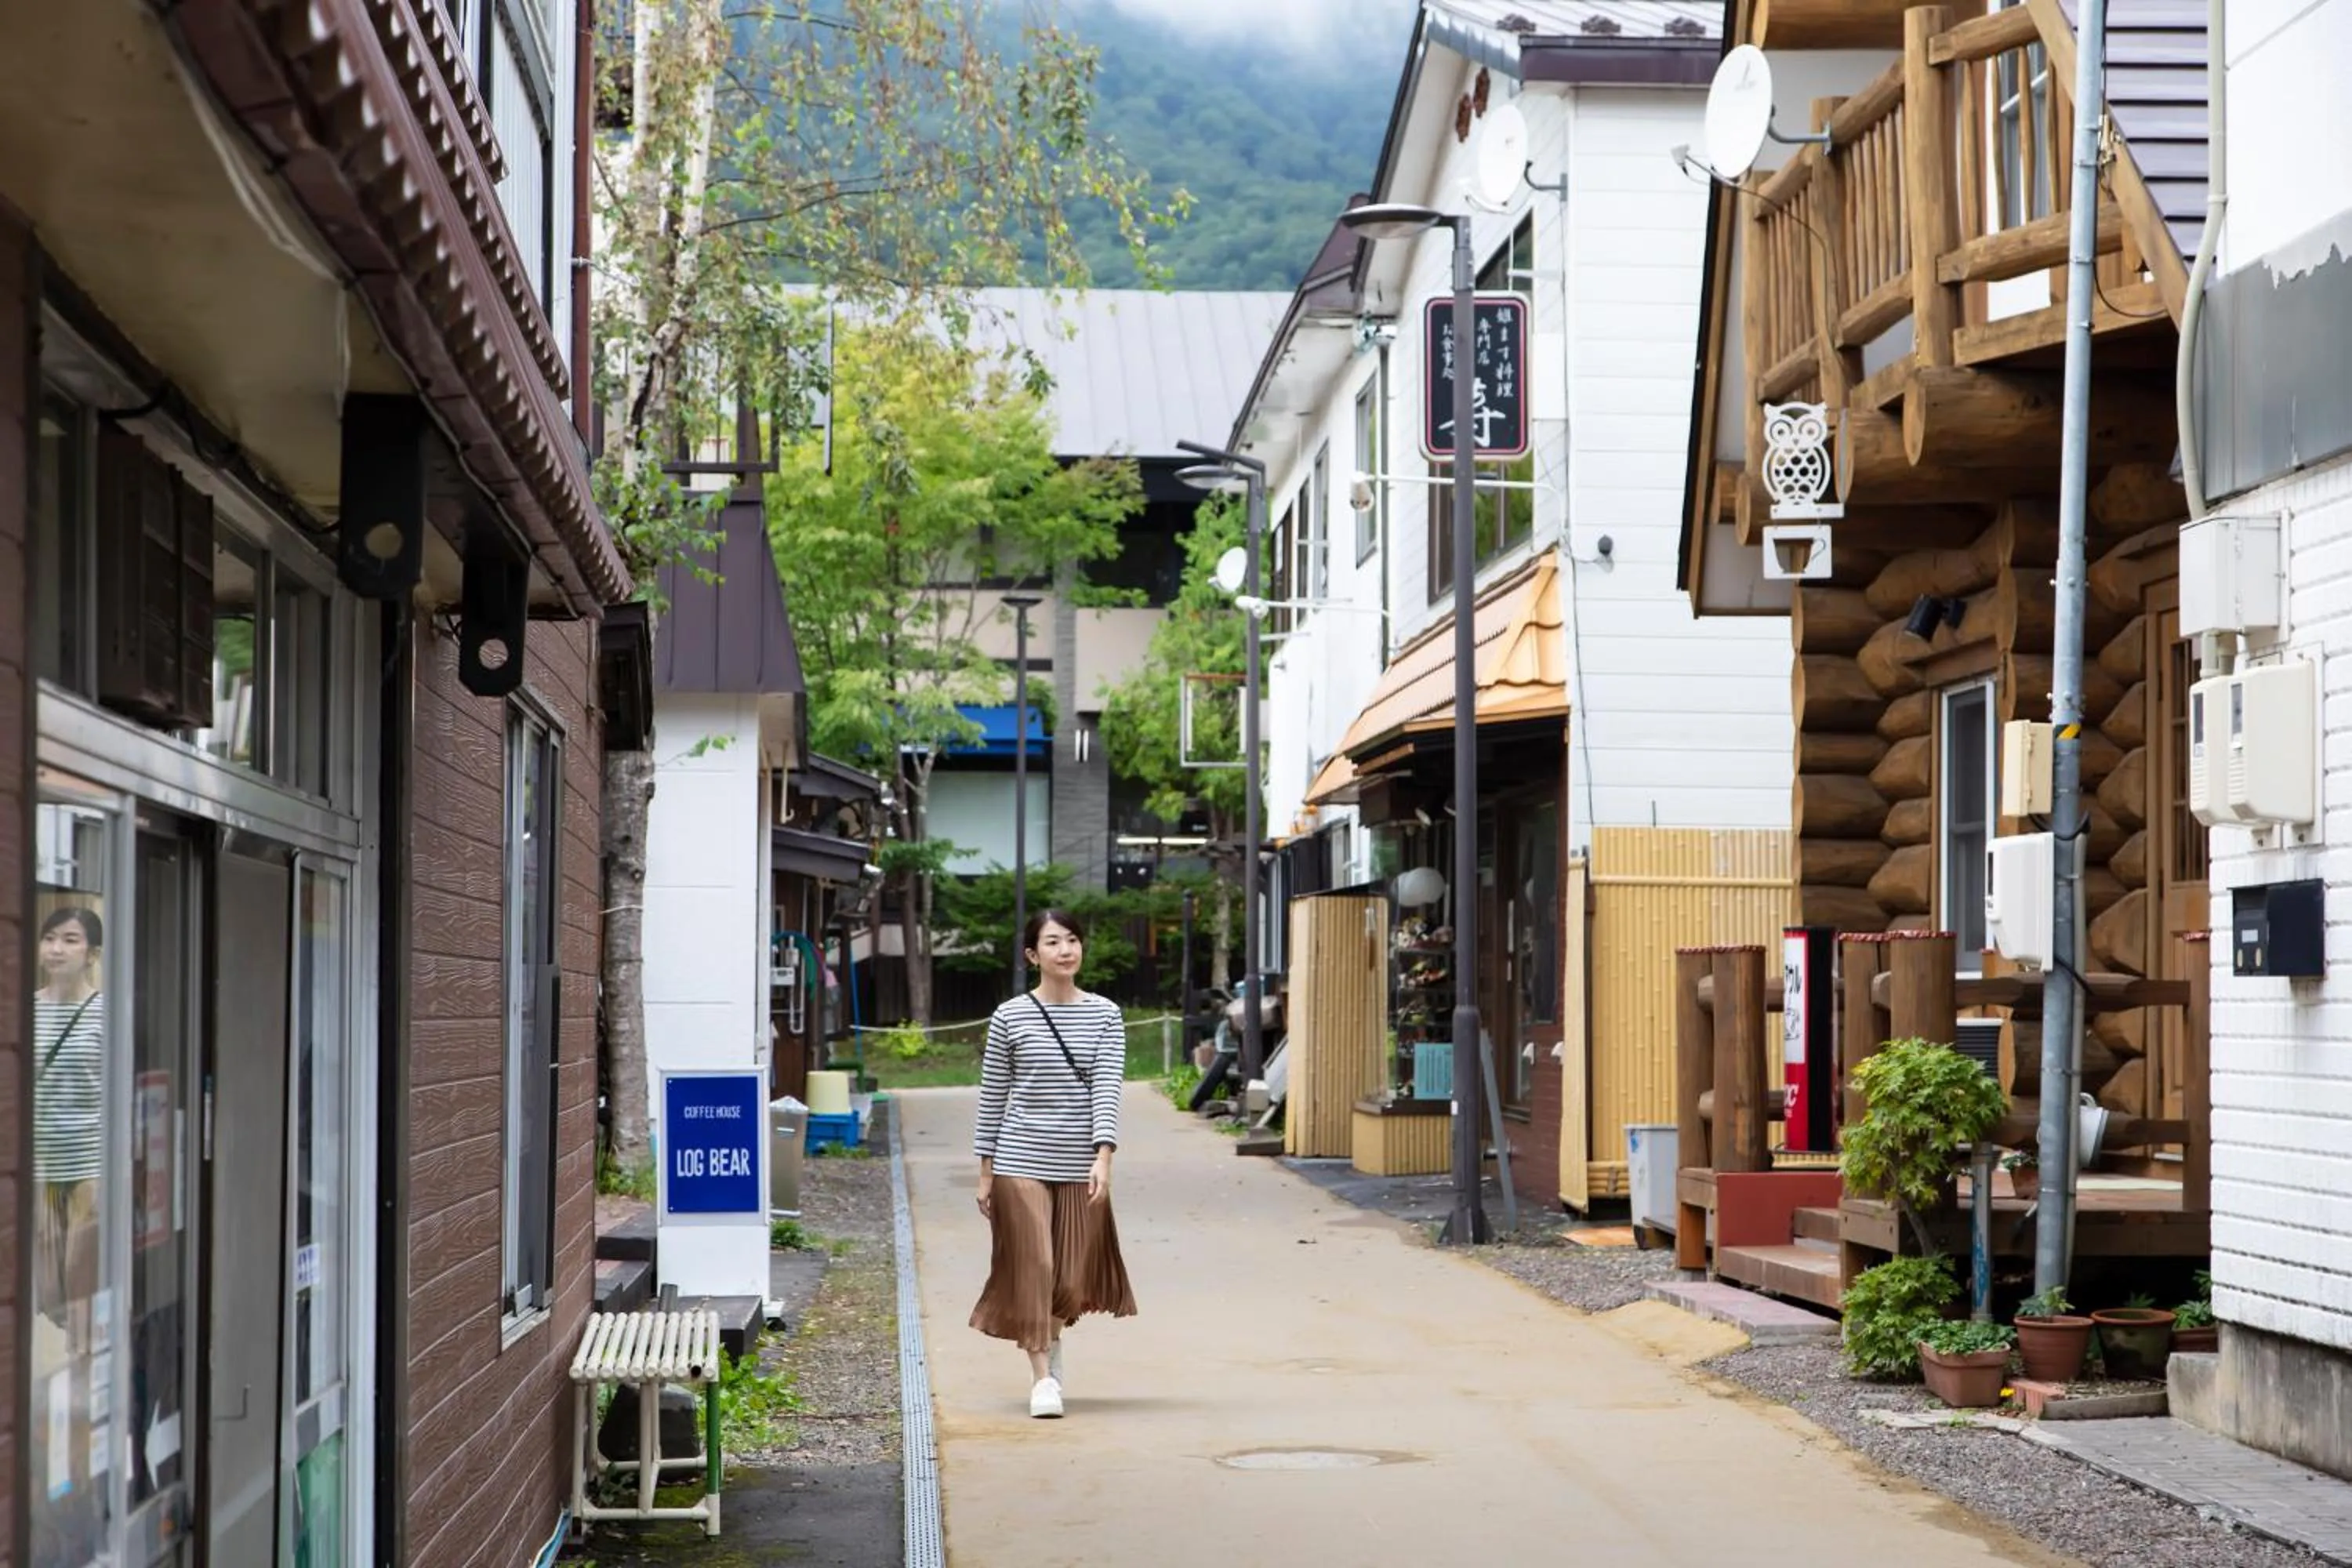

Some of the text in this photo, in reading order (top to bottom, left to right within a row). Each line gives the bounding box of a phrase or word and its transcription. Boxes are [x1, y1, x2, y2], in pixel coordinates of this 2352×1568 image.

[684, 1105, 742, 1119] COFFEE HOUSE
[677, 1148, 750, 1177] LOG BEAR
